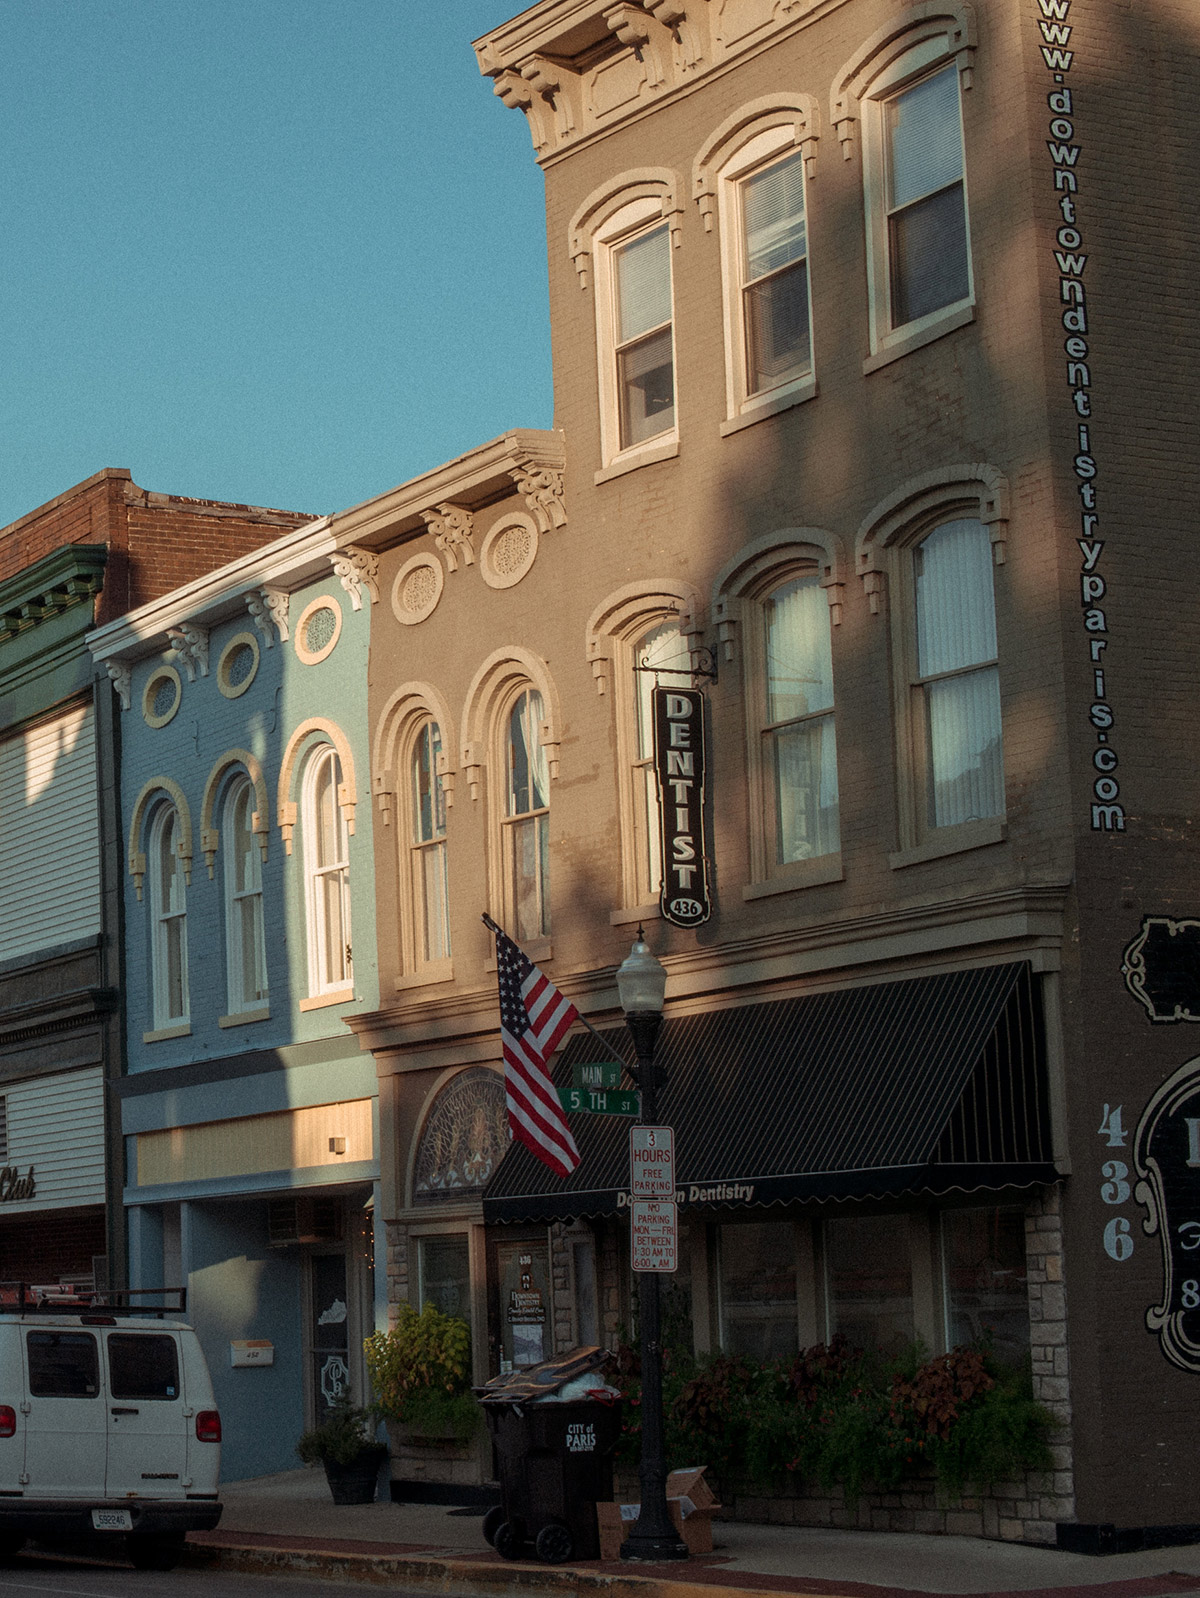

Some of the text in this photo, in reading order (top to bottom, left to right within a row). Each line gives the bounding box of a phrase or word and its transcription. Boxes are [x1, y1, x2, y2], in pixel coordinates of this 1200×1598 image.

[665, 693, 698, 890] DENTIST
[674, 901, 697, 915] 436
[581, 1066, 617, 1084] MAIN ST
[570, 1091, 631, 1111] 5 TH ST
[648, 1133, 657, 1147] 3
[634, 1149, 671, 1163] HOURS
[643, 1169, 663, 1178] FREE
[0, 1166, 36, 1202] Club
[634, 1181, 671, 1191] PARKING
[689, 1183, 755, 1203] Dentistry
[647, 1203, 660, 1213] NO
[637, 1214, 671, 1224] PARKING
[637, 1236, 672, 1246] BETWEEN
[652, 1248, 664, 1257] AM
[664, 1248, 675, 1258] TO
[658, 1259, 670, 1268] AM
[567, 1423, 595, 1434] CITY of
[565, 1433, 598, 1448] PARIS
